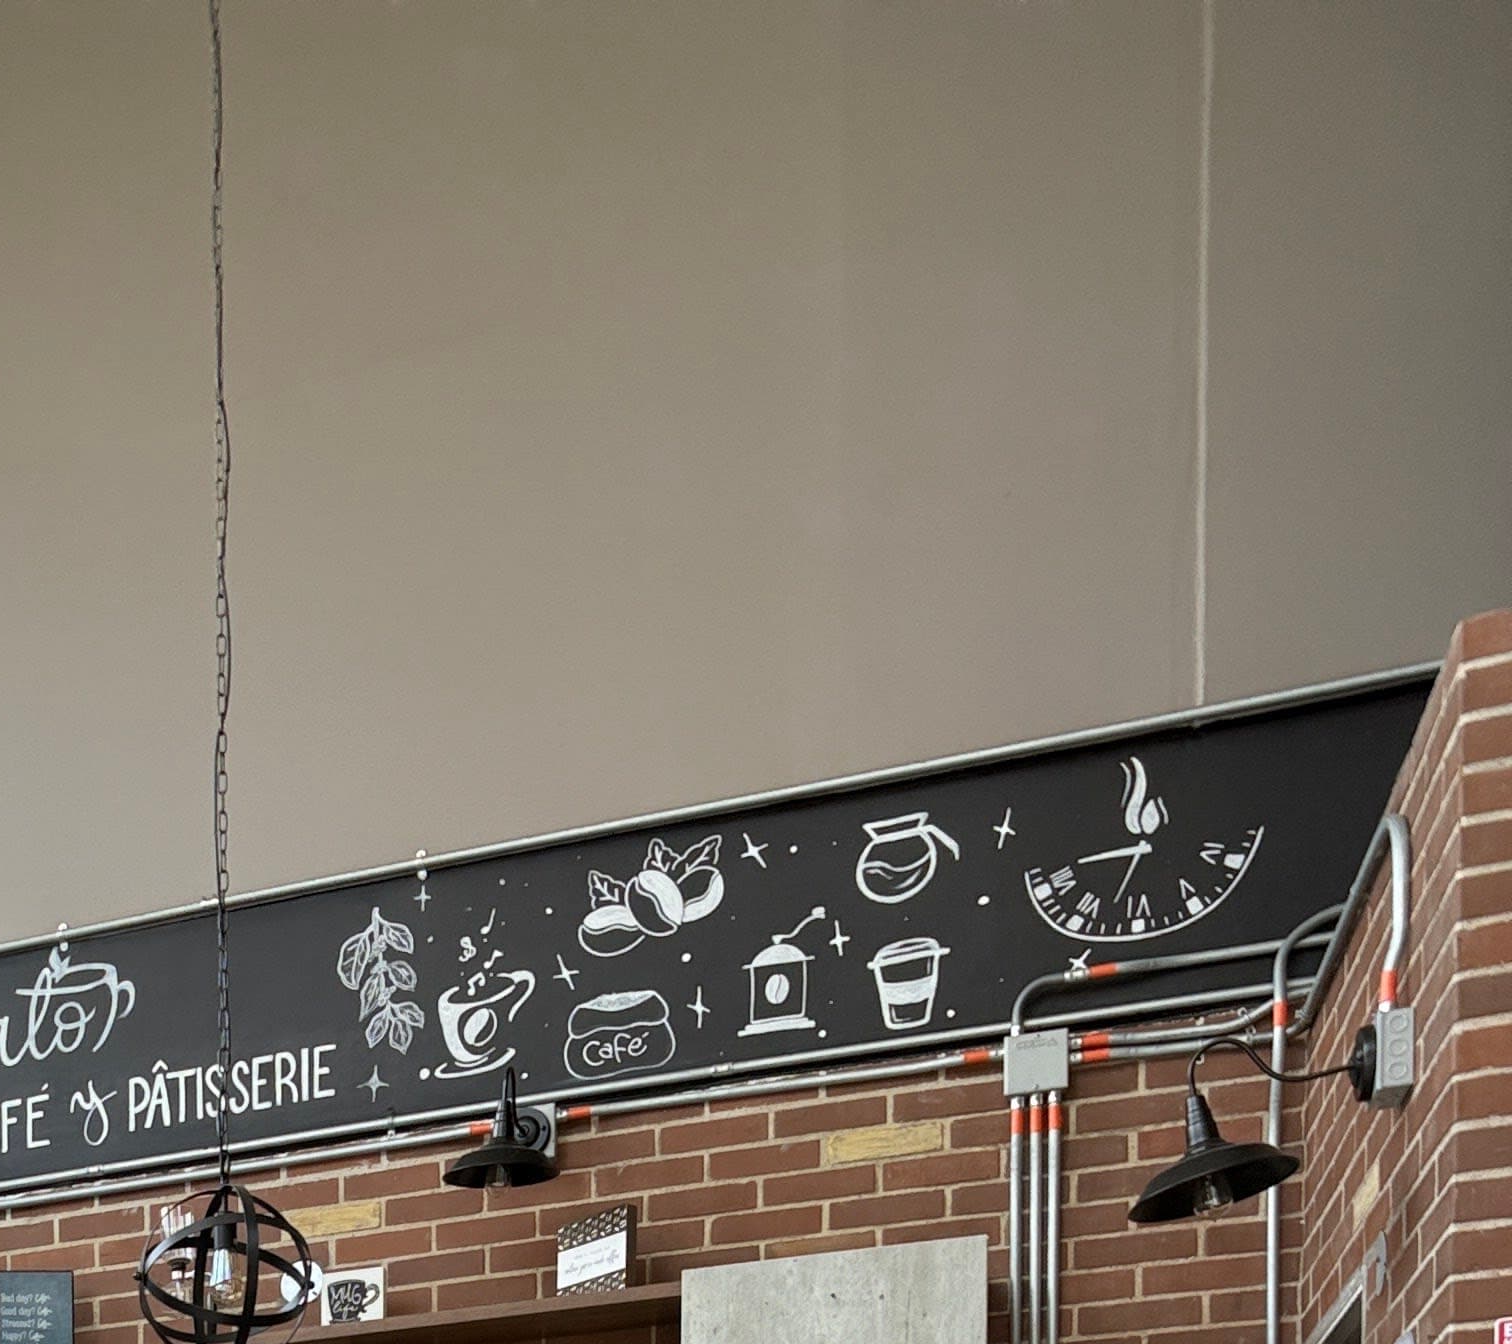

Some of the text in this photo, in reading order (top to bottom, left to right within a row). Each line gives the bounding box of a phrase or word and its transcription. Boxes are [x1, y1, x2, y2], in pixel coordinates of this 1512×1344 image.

[582, 1031, 649, 1067] Café
[127, 1044, 337, 1133] PÂTISSERIE
[330, 1283, 362, 1305] MUG
